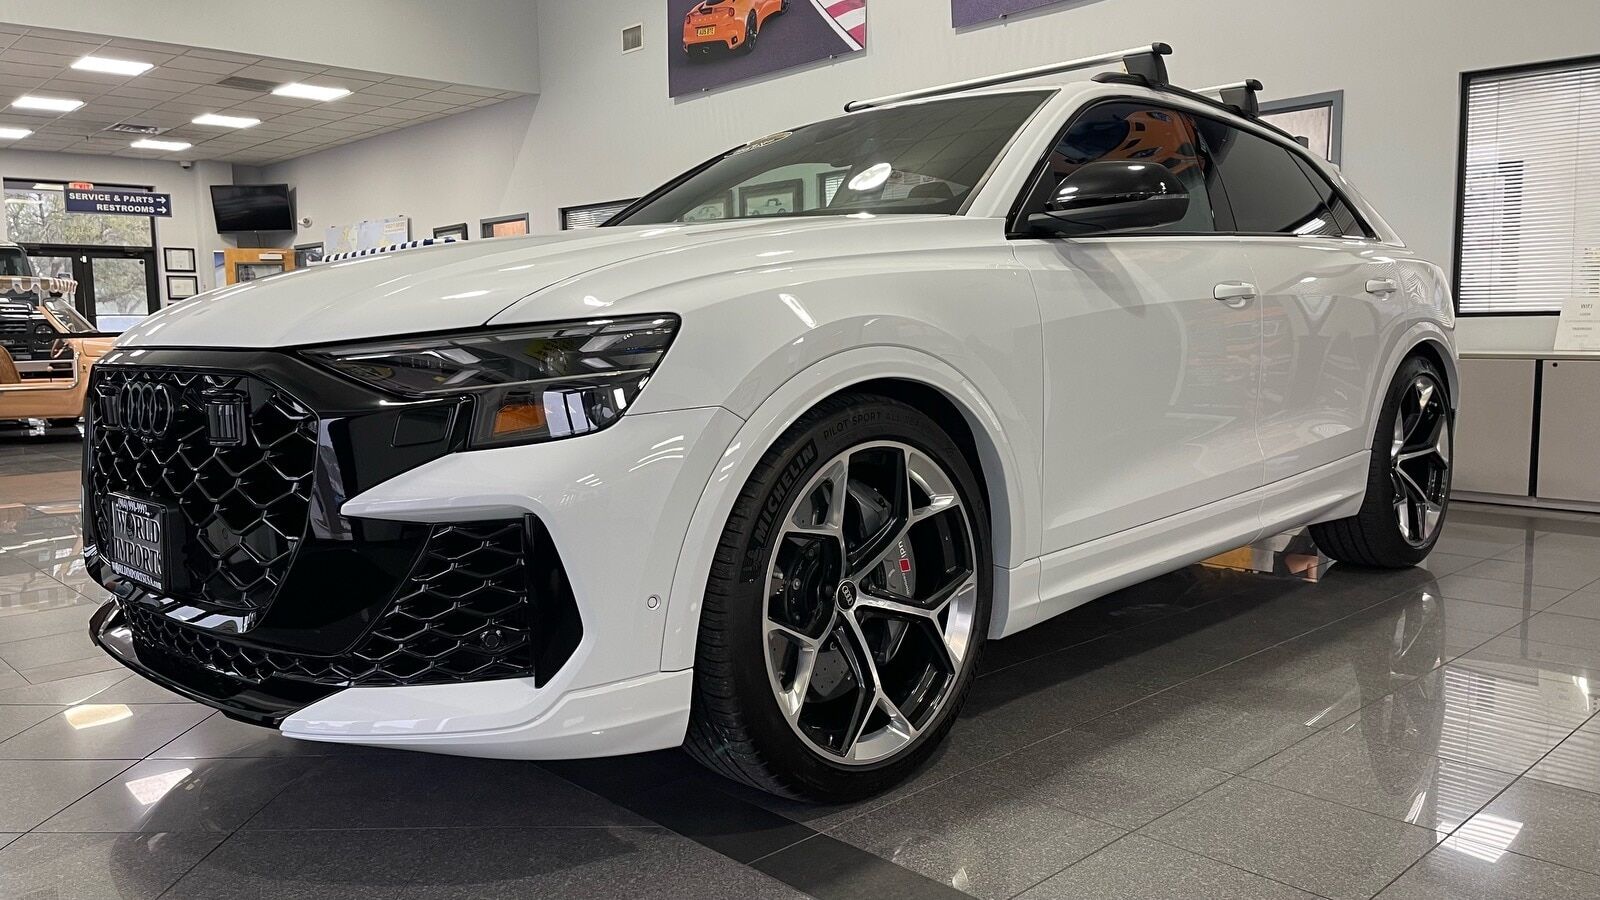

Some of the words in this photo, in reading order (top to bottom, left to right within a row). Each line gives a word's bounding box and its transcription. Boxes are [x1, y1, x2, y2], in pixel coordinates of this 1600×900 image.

[69, 192, 111, 201] SERVICE
[123, 195, 154, 203] PARTS
[96, 203, 155, 213] RESTROOMS
[823, 420, 849, 440] PILOT
[852, 411, 881, 426] SPORT
[754, 443, 817, 544] MICHELIN
[116, 508, 161, 543] WORLD
[897, 540, 907, 558] udi
